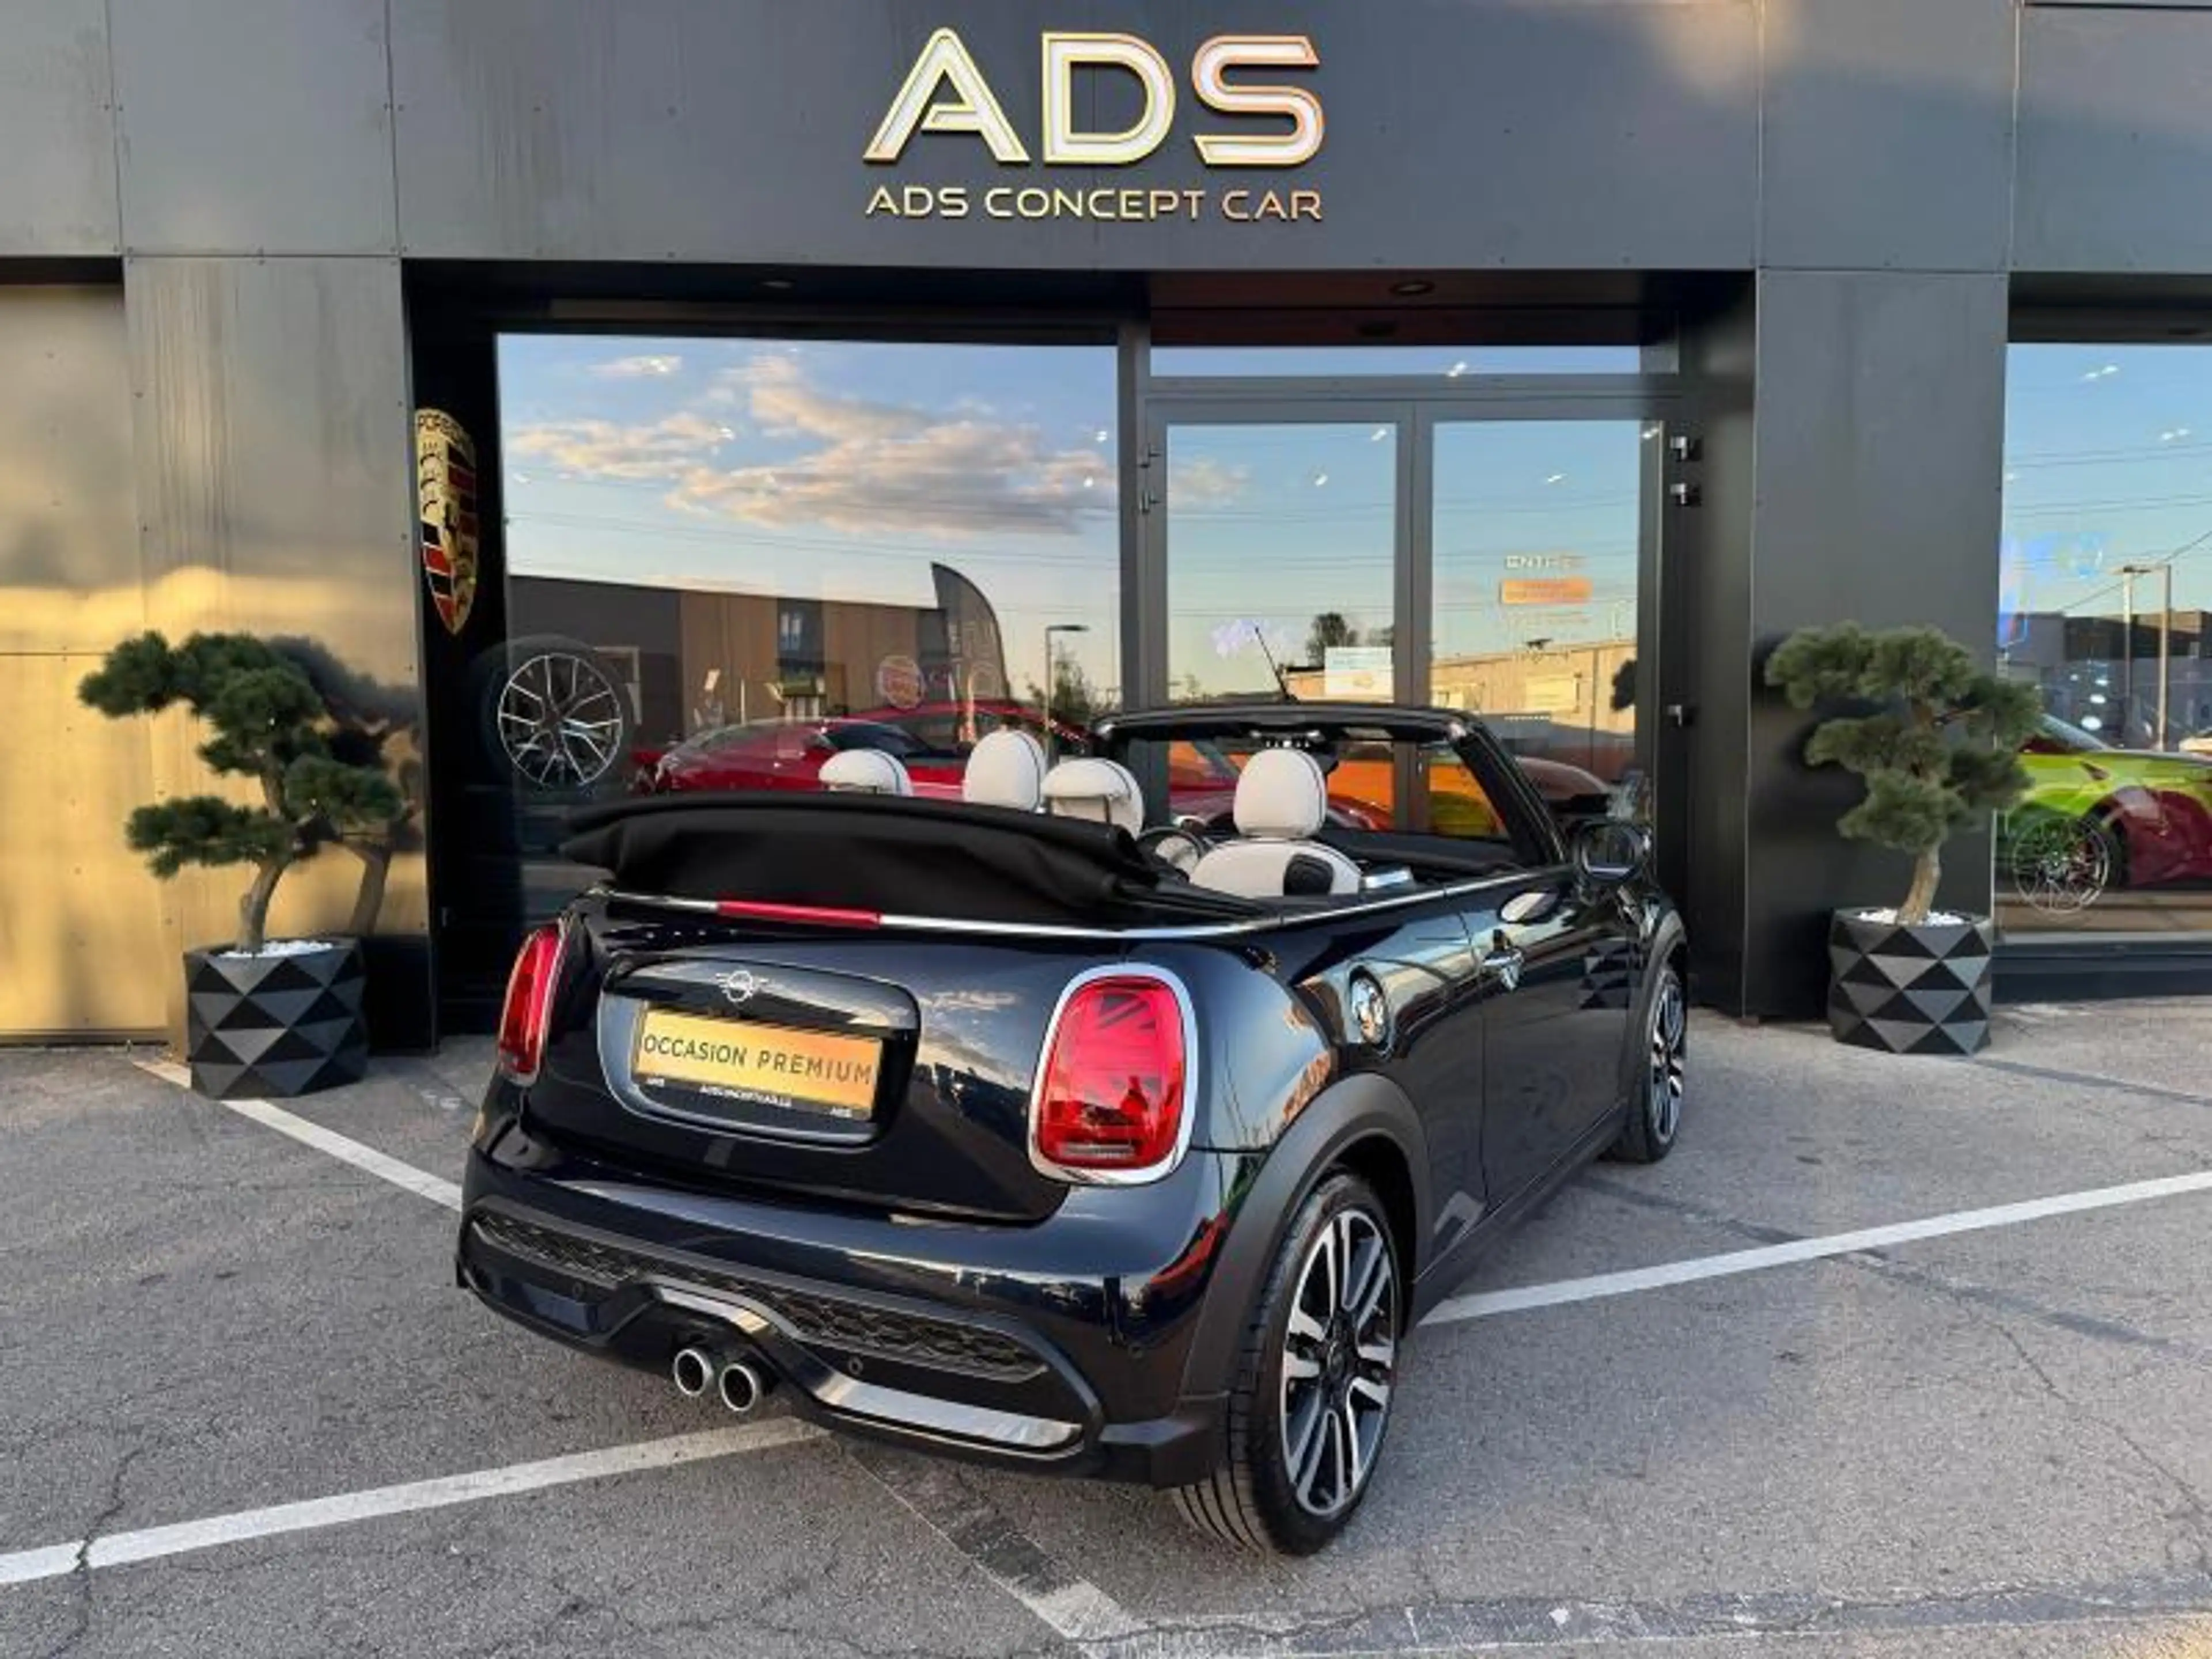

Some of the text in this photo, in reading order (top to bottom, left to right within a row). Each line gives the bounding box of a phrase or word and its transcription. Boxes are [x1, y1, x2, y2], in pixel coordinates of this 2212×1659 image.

[863, 27, 1325, 165] ADS
[866, 185, 1322, 220] ADS CONCEPT CAR
[644, 1034, 872, 1085] OCCASION PREMIUM
